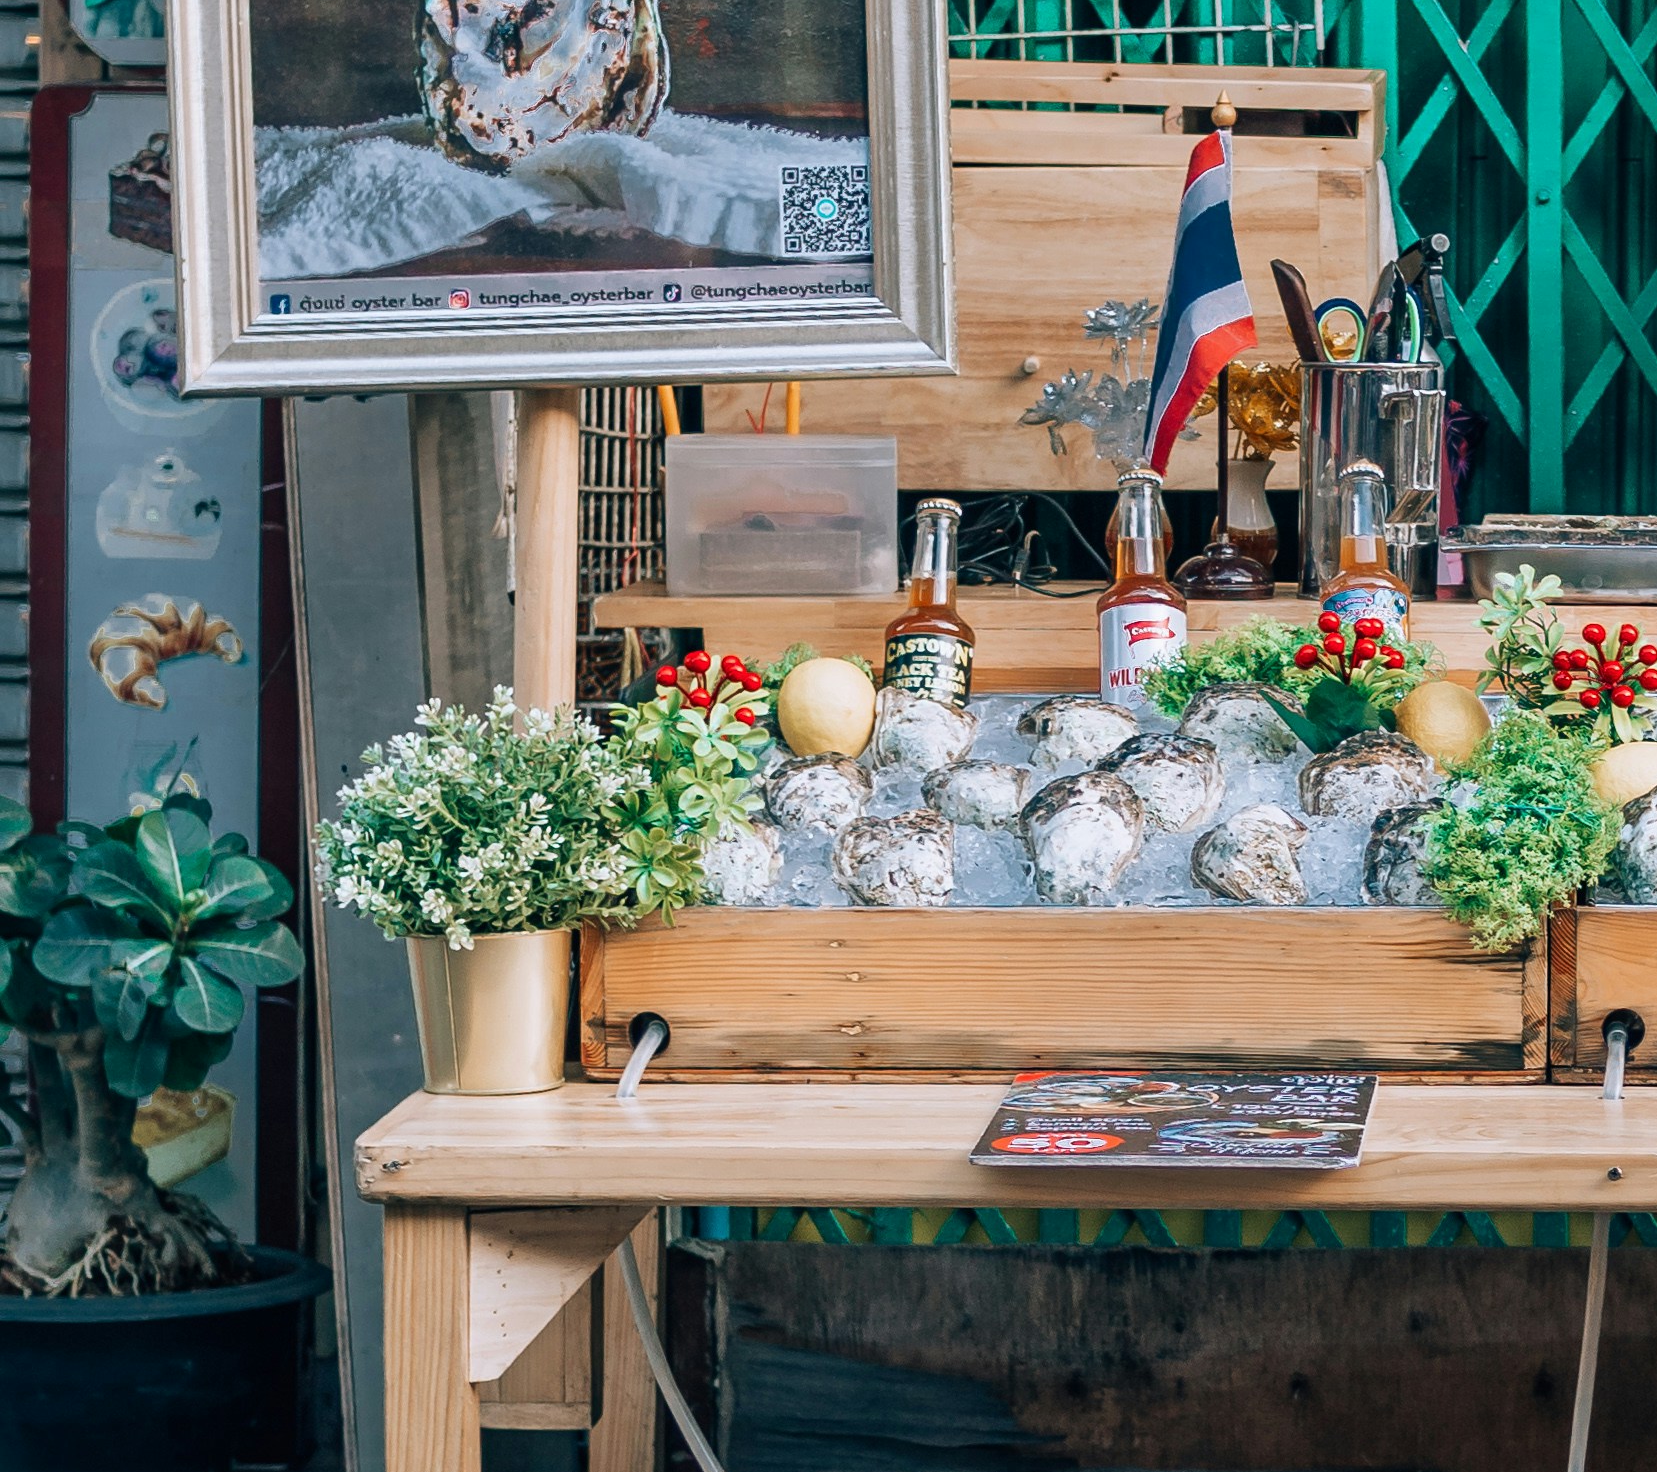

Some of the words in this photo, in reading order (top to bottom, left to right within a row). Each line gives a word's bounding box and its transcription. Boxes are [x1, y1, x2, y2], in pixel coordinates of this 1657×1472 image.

[478, 287, 654, 308] tungchae_oysterbar
[690, 280, 872, 302] @tungchaeoysterbar
[352, 295, 406, 312] oyster
[412, 292, 442, 308] bar
[936, 664, 966, 683] TEA
[1186, 1084, 1361, 1096] OYSTER
[1270, 1094, 1358, 1104] BAR
[1007, 1137, 1107, 1149] 50
